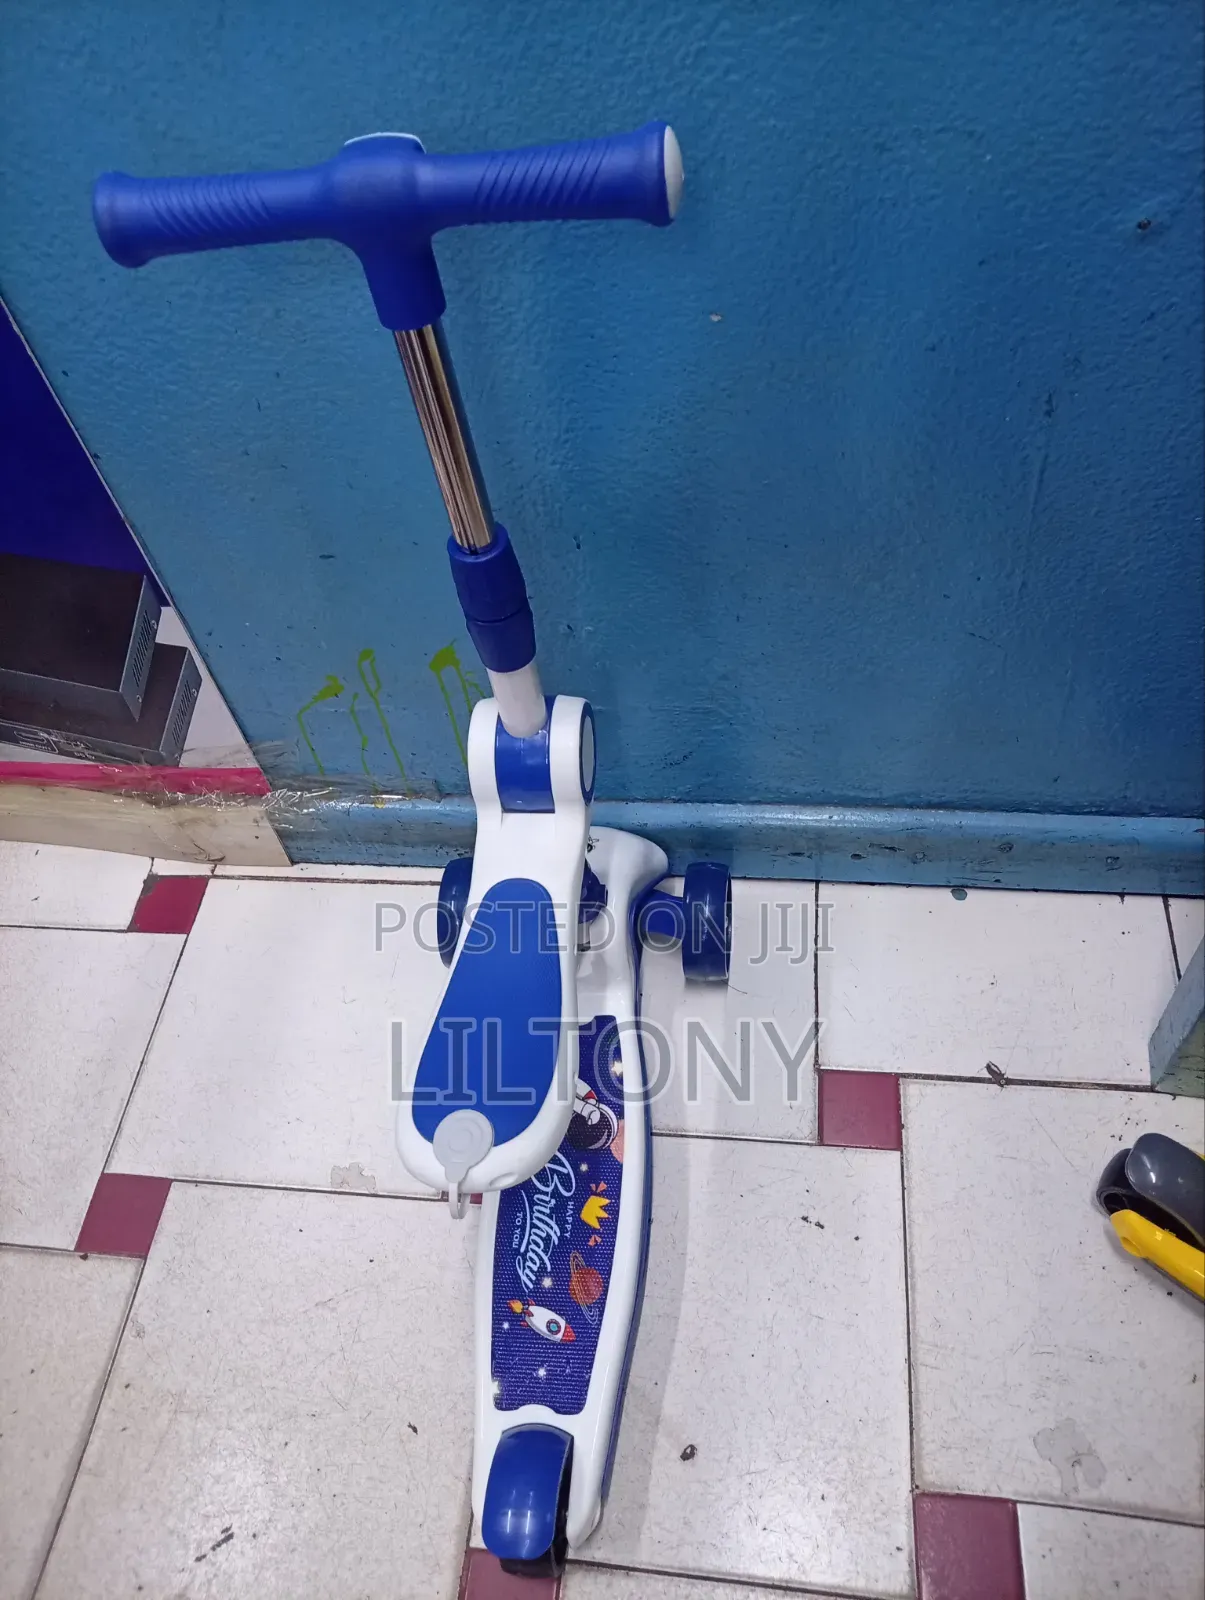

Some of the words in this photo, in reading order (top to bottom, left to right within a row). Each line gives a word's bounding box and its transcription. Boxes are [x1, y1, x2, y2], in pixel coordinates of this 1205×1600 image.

[514, 1211, 523, 1226] TO
[517, 1151, 576, 1293] Birthday
[565, 1201, 575, 1239] HAPPY
[512, 1228, 521, 1249] YOU
